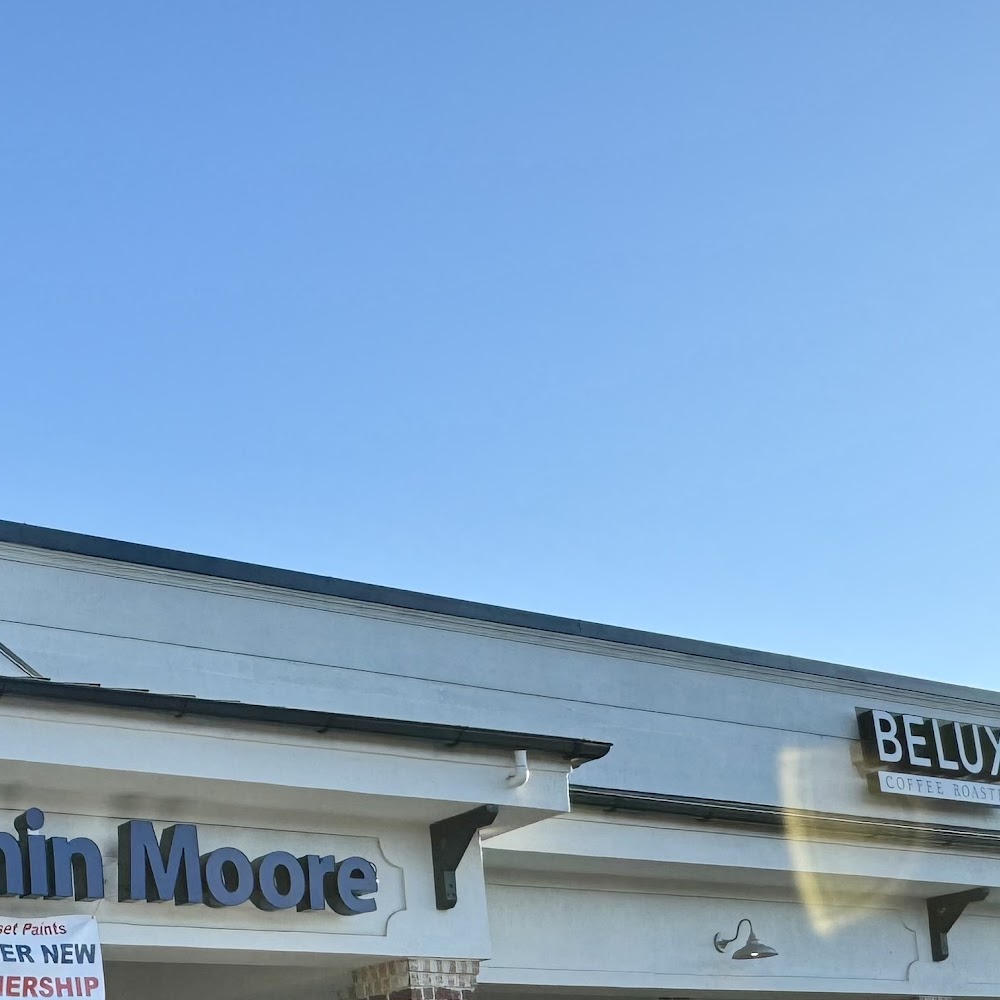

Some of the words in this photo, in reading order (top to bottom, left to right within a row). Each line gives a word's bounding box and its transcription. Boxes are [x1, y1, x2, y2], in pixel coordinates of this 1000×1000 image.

[885, 775, 944, 795] COFFEE
[117, 819, 378, 916] Moore
[22, 922, 67, 936] Paints
[41, 943, 96, 964] NEW
